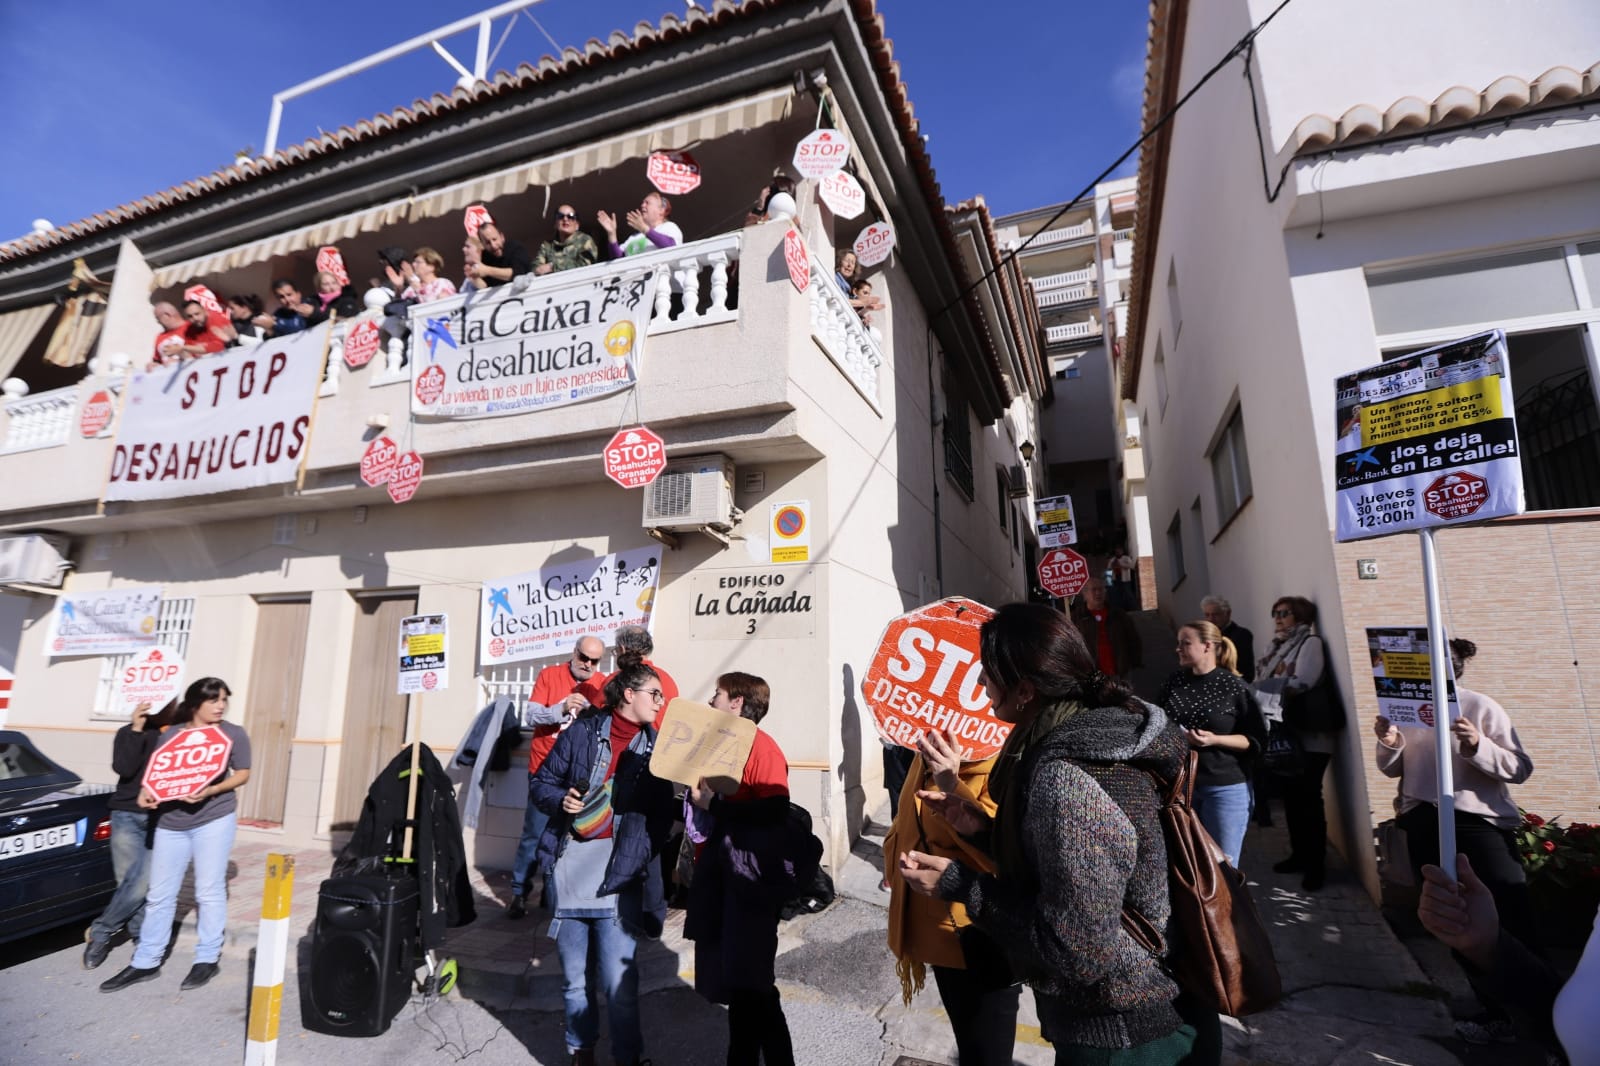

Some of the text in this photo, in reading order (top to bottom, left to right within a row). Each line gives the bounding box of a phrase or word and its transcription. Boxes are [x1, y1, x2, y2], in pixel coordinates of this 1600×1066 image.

[800, 144, 845, 156] STOP
[652, 158, 698, 175] STOP
[823, 177, 861, 199] STOP
[856, 230, 890, 252] STOP
[347, 329, 378, 350] STOP
[181, 352, 287, 411] STOP
[454, 384, 489, 403] vivienda
[492, 386, 504, 401] no
[506, 383, 518, 397] es
[520, 382, 533, 396] un
[556, 376, 568, 390] es
[570, 363, 627, 388] necesidad
[1370, 398, 1430, 417] Un menor,
[1370, 415, 1391, 425] una
[1394, 403, 1433, 420] madre
[1436, 392, 1483, 409] soltera
[1438, 414, 1459, 426] del
[1463, 406, 1492, 420] 65%
[1370, 403, 1477, 434] y una señora con
[110, 414, 311, 483] DESAHUCIOS
[363, 446, 395, 469] STOP
[608, 443, 661, 465] STOP
[1390, 432, 1483, 464] ¡los deja
[1390, 439, 1516, 475] en la calle!
[391, 462, 420, 483] STOP
[610, 458, 662, 473] Desahucios
[618, 467, 657, 480] Granada
[1356, 487, 1415, 507] Jueves
[1427, 480, 1484, 503] STOP
[1429, 492, 1486, 510] Desahucios
[1357, 498, 1415, 516] 30 enero
[1437, 500, 1479, 514] Granada
[1356, 509, 1415, 528] 12:00h
[1041, 560, 1084, 578] STOP
[1044, 573, 1086, 585] Desahucios
[1367, 563, 1376, 574] 6
[517, 566, 608, 607] "la Caixa"
[719, 573, 785, 589] EDIFICIO
[1050, 579, 1082, 591] Granada
[695, 590, 812, 617] La Cañada
[490, 594, 624, 637] desahucia,
[507, 637, 516, 646] La
[518, 631, 551, 645] vivienda
[551, 631, 562, 639] no
[564, 630, 574, 638] es
[575, 626, 586, 634] un
[608, 622, 618, 630] es
[746, 618, 757, 635] 3
[124, 664, 179, 685] STOP
[887, 626, 995, 716] STO
[872, 677, 1010, 748] DESAHUCIOS
[154, 743, 225, 771] STOP
[149, 763, 220, 782] Desahucios
[154, 774, 208, 791] Granada
[33, 827, 70, 849] DGF
